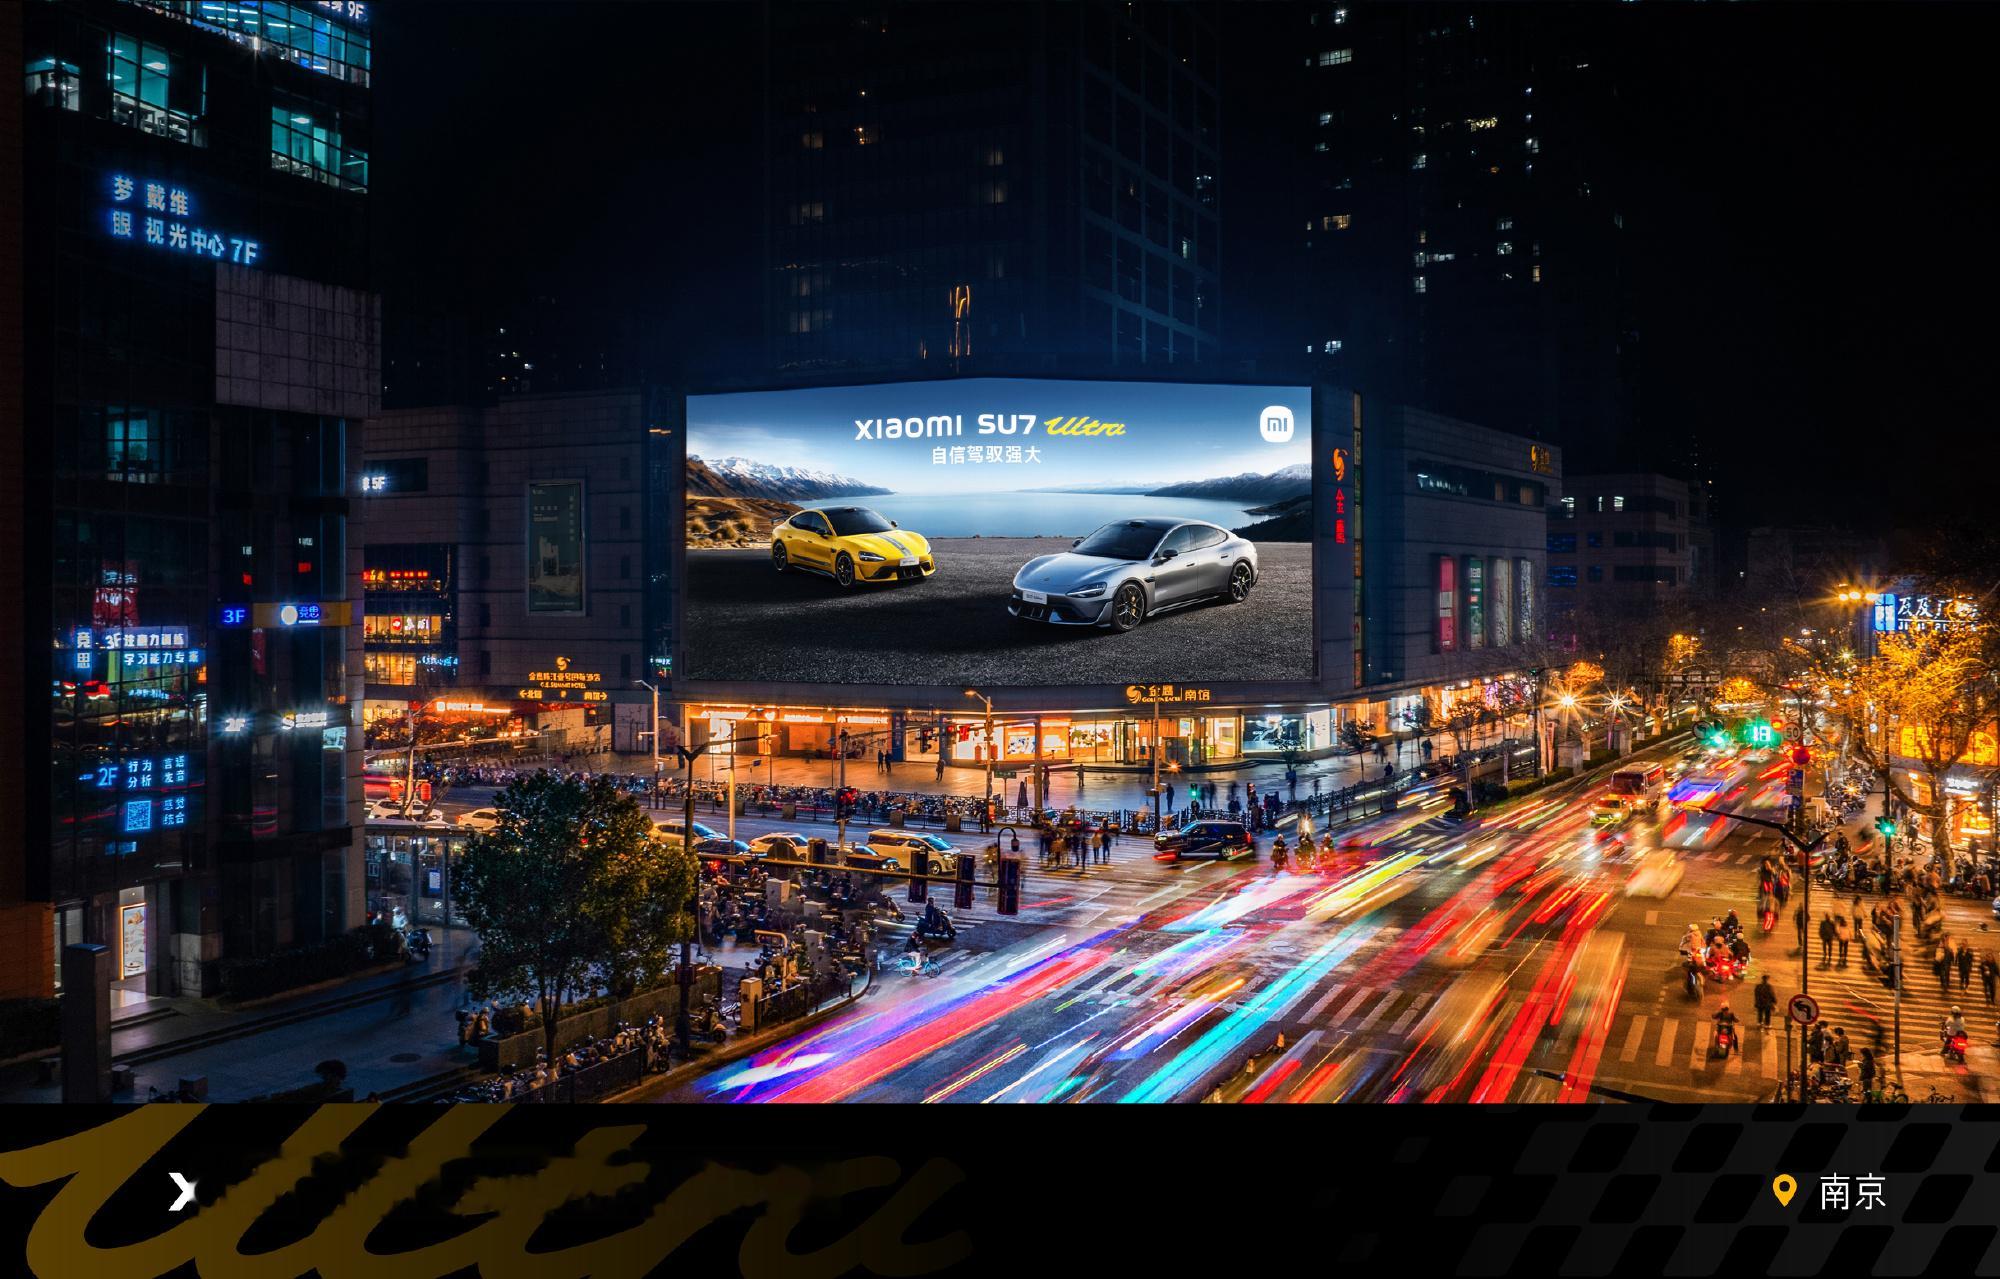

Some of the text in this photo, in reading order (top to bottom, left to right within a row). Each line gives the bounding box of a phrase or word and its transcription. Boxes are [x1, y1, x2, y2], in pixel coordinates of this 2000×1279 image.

[348, 0, 365, 19] 9F
[229, 239, 259, 264] 7F
[977, 413, 1037, 435] SU7
[1043, 415, 1127, 437] Ultra
[931, 445, 1042, 465] 自信驾驭强大
[371, 476, 385, 490] 5F
[223, 609, 246, 624] 3F
[105, 632, 122, 649] 3F
[225, 718, 246, 731] 2F
[1786, 727, 1798, 738] 50
[128, 760, 153, 773] 行为
[97, 767, 119, 786] 2F
[128, 774, 153, 789] 分析
